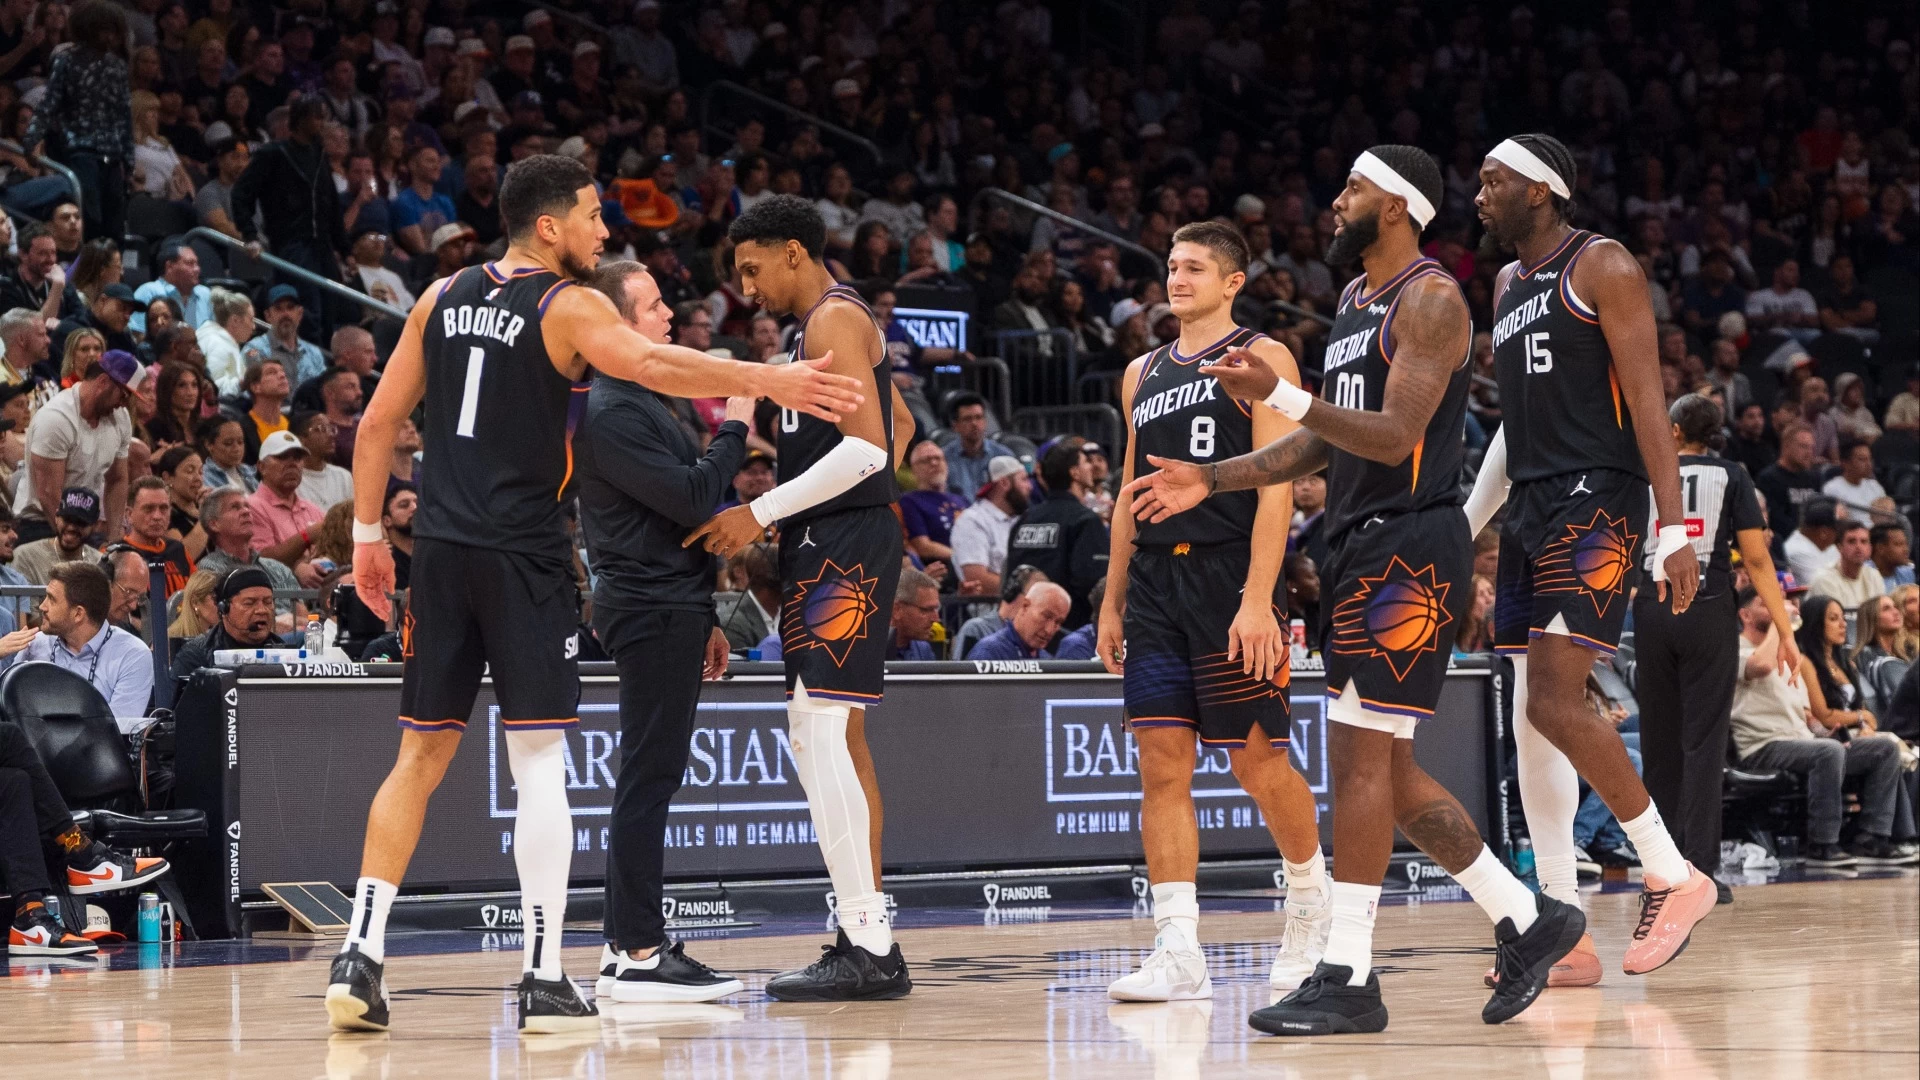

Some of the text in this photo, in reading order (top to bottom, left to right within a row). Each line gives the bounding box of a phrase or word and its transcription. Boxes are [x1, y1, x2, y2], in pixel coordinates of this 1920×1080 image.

[1534, 271, 1558, 281] PayPal
[1368, 303, 1388, 315] PayPal
[1493, 289, 1553, 353] PHOENIX
[443, 305, 525, 347] BOOKER
[1525, 332, 1553, 374] 15
[456, 346, 485, 438] 1
[1335, 372, 1364, 411] 00
[1132, 377, 1219, 434] PHOENIX
[1190, 416, 1216, 457] 8
[1016, 526, 1058, 544] SECURITY
[305, 663, 369, 676] FANDUEL
[992, 661, 1043, 673] FANDUEL
[1290, 658, 1325, 671] NDUEL
[227, 708, 238, 769] FANDUEL
[1056, 812, 1130, 834] PREMIUM
[1232, 807, 1252, 828] ON
[715, 823, 737, 846] ON
[230, 842, 240, 902] FANDUEL
[1001, 885, 1051, 900] FANDUEL
[678, 901, 735, 916] FANDUEL
